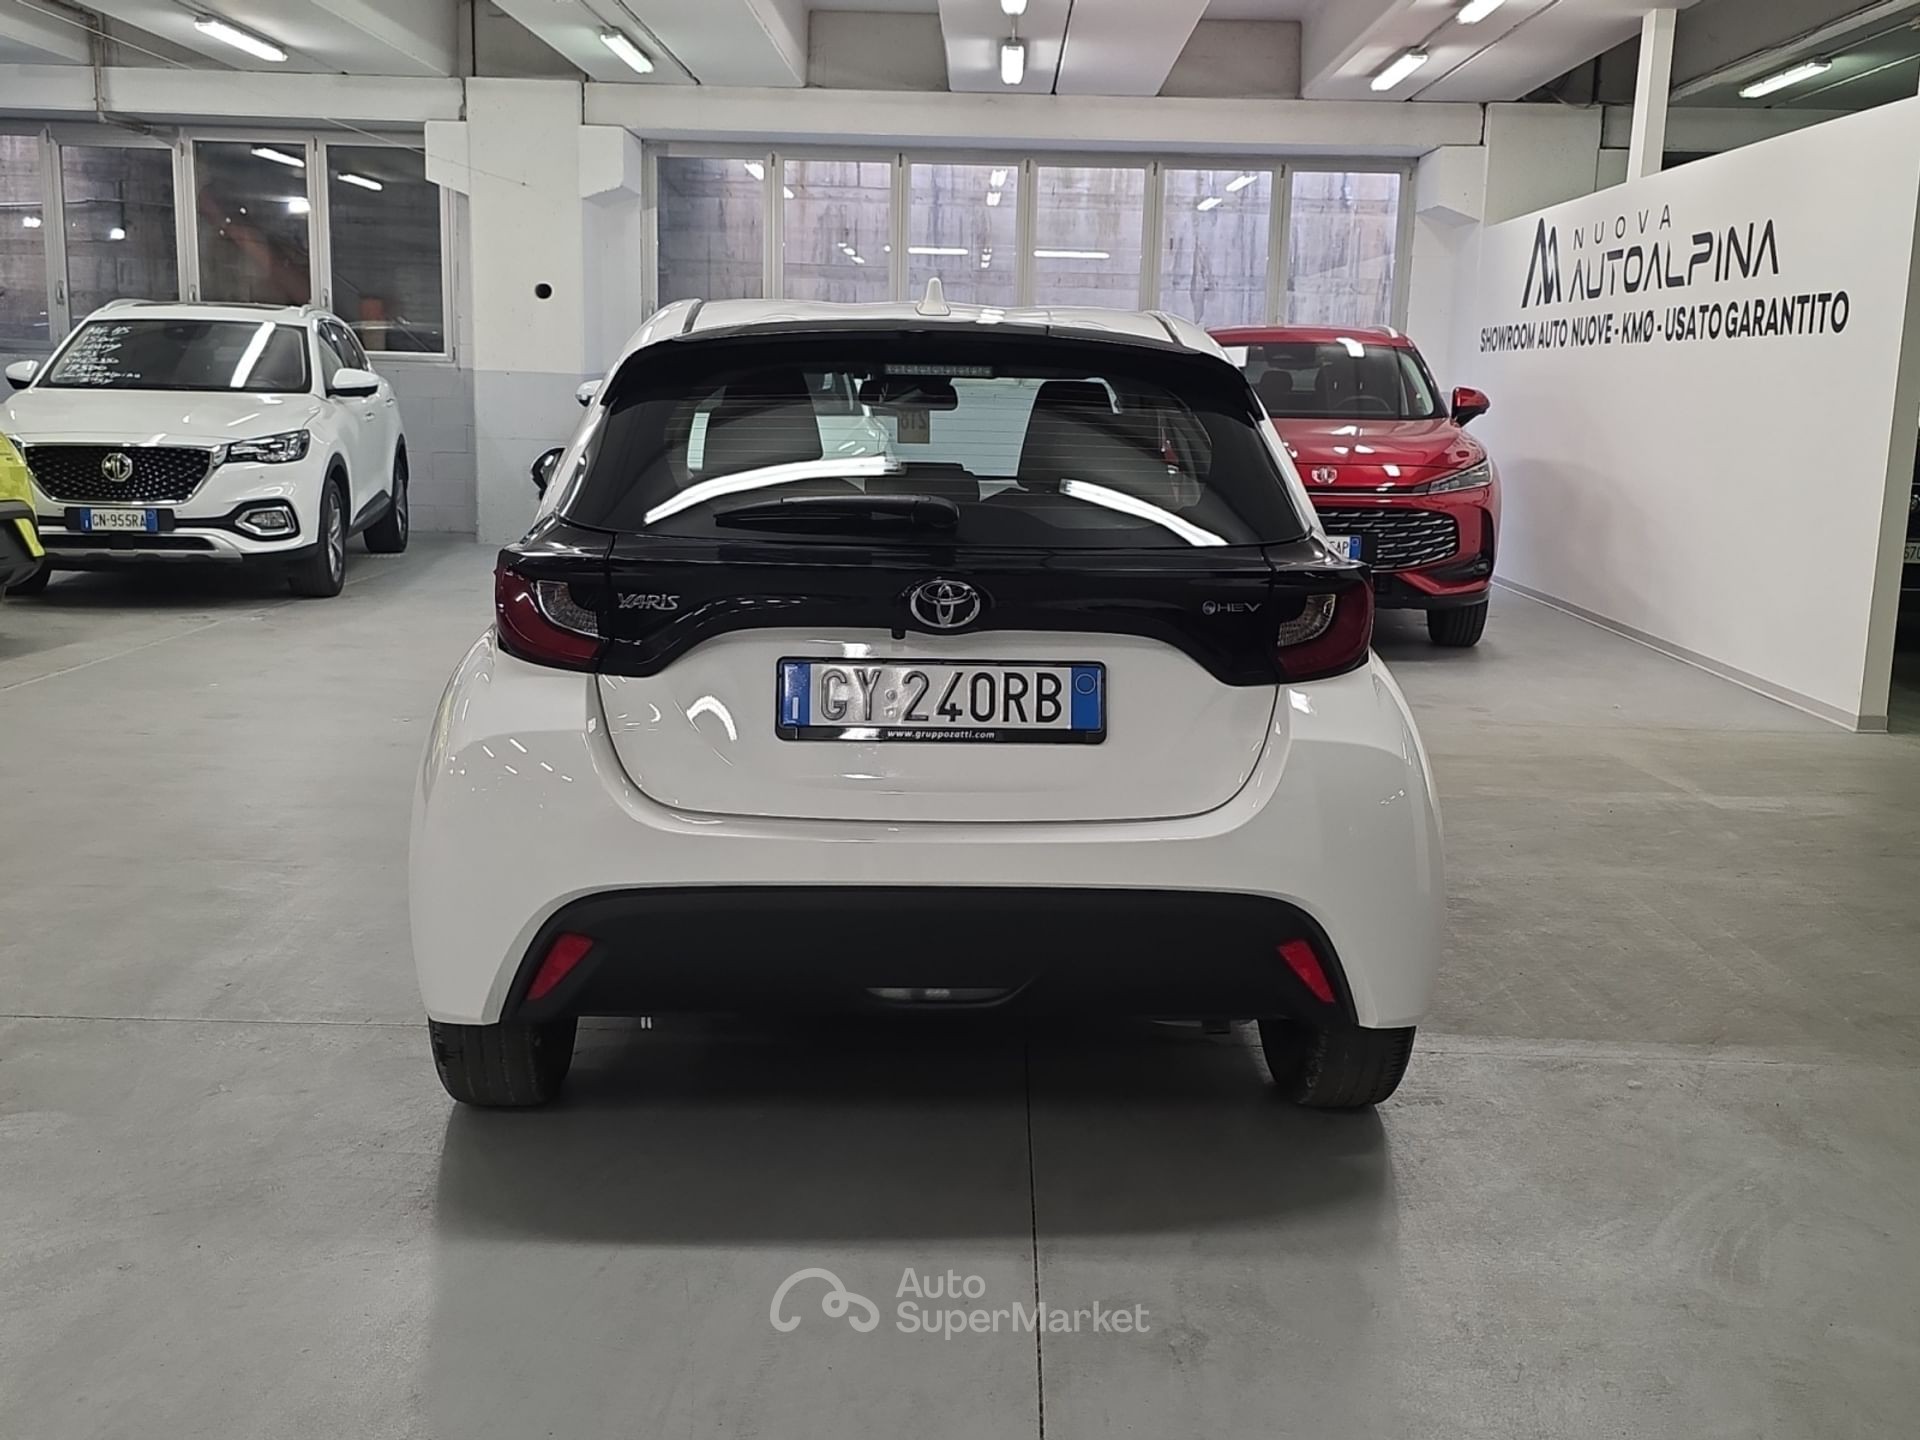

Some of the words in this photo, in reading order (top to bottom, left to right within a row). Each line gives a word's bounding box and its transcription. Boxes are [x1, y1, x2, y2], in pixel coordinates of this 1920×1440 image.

[1573, 204, 1672, 250] NUOVA
[1568, 219, 1779, 303] AUTOALPINA
[1480, 322, 1536, 353] SHOWROOM
[1537, 318, 1568, 350] AUTO
[1570, 313, 1613, 347] NUOVE
[1665, 303, 1722, 341] USATO
[1725, 291, 1850, 339] GARANTITO
[617, 592, 681, 611] YARIS
[1217, 602, 1263, 613] HEV
[820, 668, 881, 722] GY
[902, 670, 1063, 723] 240RB
